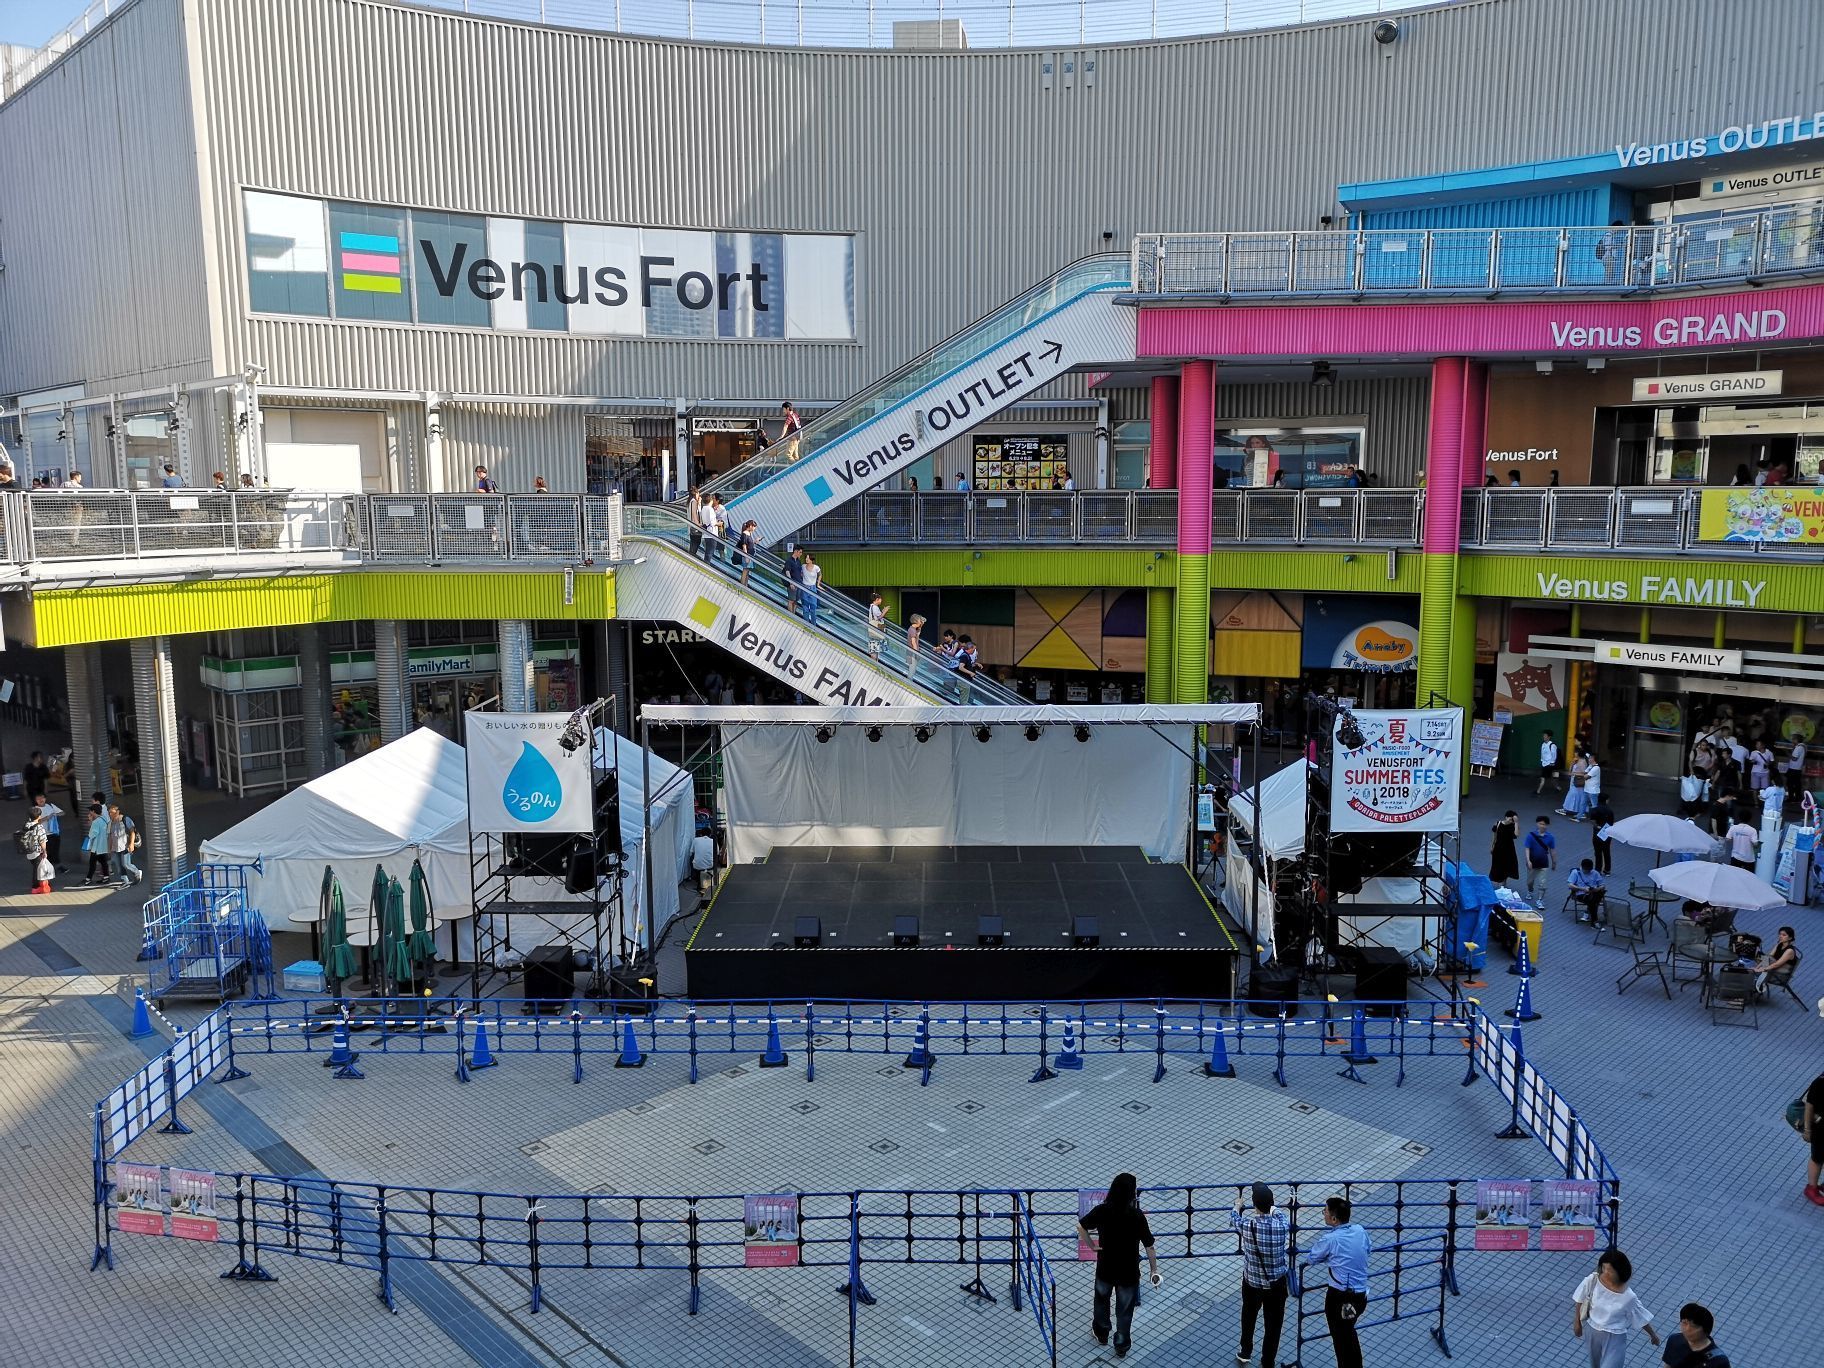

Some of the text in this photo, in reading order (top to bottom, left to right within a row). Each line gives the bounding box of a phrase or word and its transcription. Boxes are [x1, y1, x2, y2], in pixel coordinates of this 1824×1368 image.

[1615, 112, 1824, 168] Venus OUTLE
[1728, 177, 1768, 191] Venus
[1550, 309, 1787, 347] Venus GRAND
[1664, 377, 1766, 394] Venus GRAND
[696, 419, 735, 430] ZARA
[832, 351, 1035, 486] Venus OUTLET
[1537, 572, 1767, 607] Venus FAMILY
[409, 658, 471, 673] amilyMart
[726, 613, 893, 706] Venus FAM
[1625, 648, 1725, 666] Venus FAMILY
[1387, 718, 1408, 744] 夏
[1367, 757, 1425, 768] VENUSFORT
[1344, 768, 1447, 785] SUMMER FES.
[506, 788, 557, 811] うるのん
[1379, 786, 1410, 799] 2018
[1354, 801, 1435, 822] ODAIBA PALETTEPLAZA
